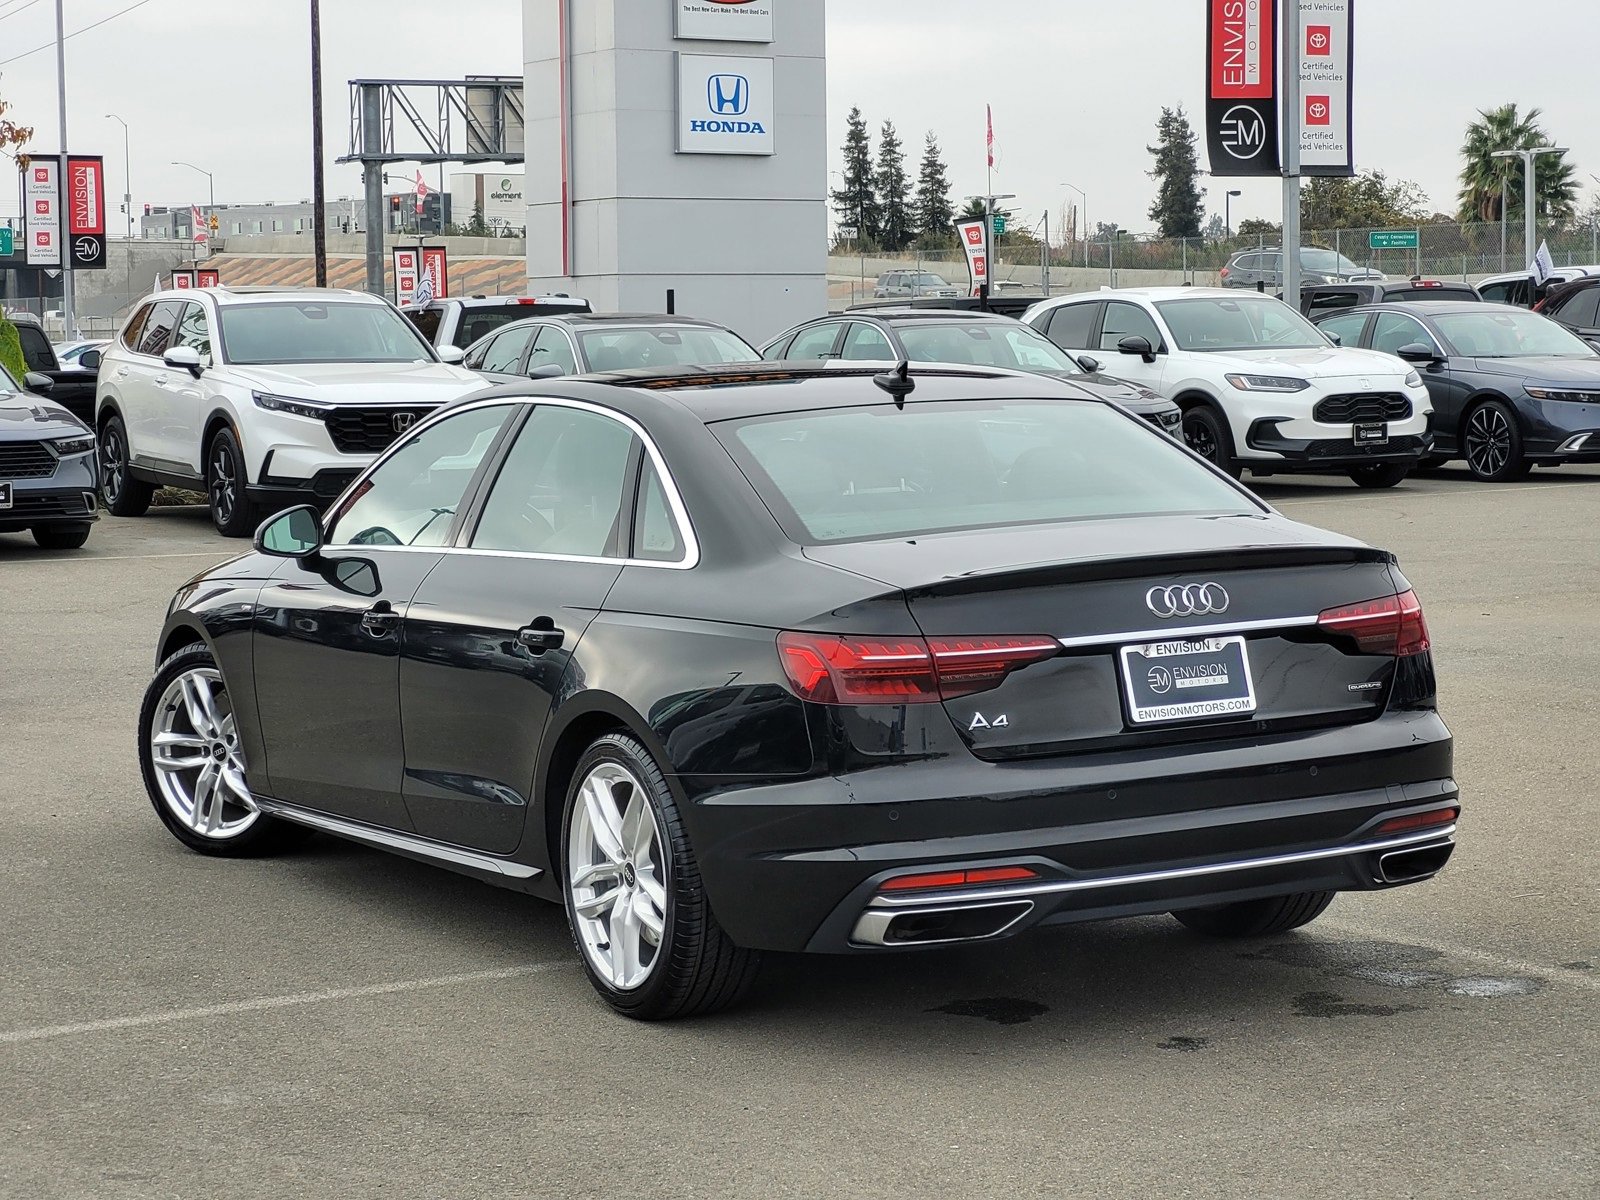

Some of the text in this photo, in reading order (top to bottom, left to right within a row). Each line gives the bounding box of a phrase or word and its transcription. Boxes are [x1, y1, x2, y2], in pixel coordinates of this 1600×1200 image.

[1299, 2, 1345, 11] sed Vehicles
[1223, 0, 1243, 85] ENVIS
[1248, 0, 1257, 74] MOTO
[1302, 61, 1334, 71] Certified
[1299, 73, 1343, 82] sed Vehicles
[690, 120, 766, 134] HONDA
[1302, 131, 1334, 140] Certified
[1299, 142, 1344, 151] sed Vehicles
[74, 166, 88, 229] ENVISION
[490, 191, 523, 200] element
[1156, 640, 1211, 655] ENVISION
[1173, 663, 1228, 679] ENVISION
[1180, 677, 1225, 686] MOTORS
[1138, 700, 1251, 719] ENVISIONMOTORS.COM
[968, 711, 1009, 731] A4
